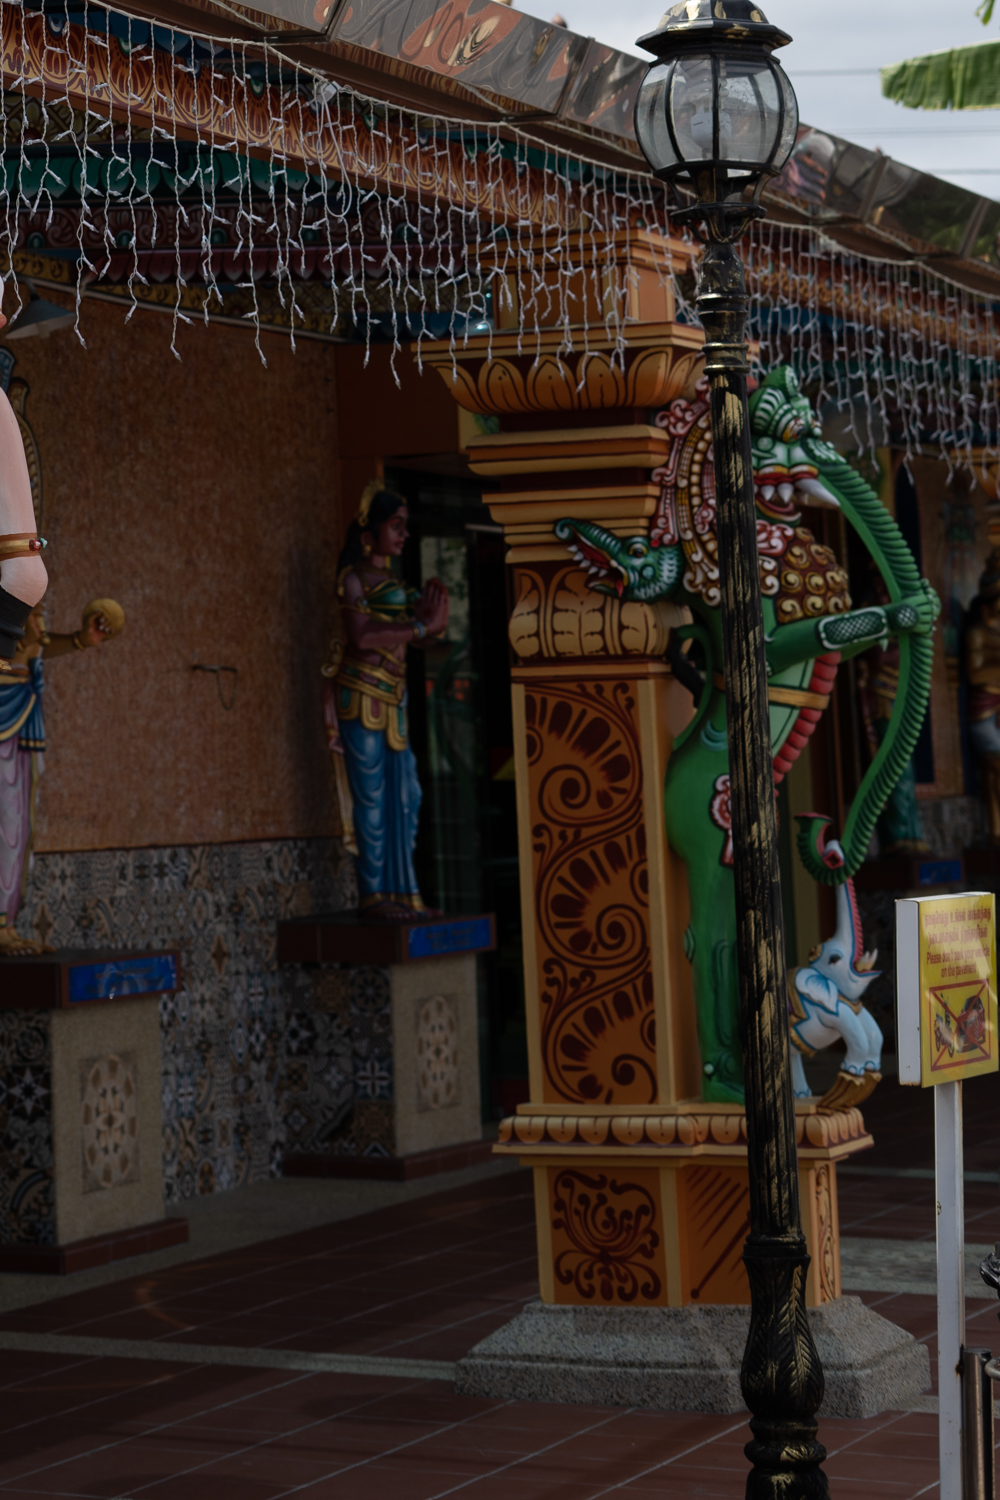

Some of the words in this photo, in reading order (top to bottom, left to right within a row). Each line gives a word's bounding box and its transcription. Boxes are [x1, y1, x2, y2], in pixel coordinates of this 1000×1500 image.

[926, 951, 941, 965] Please
[954, 947, 964, 963] park
[941, 967, 947, 978] on
[955, 963, 977, 979] pavement
